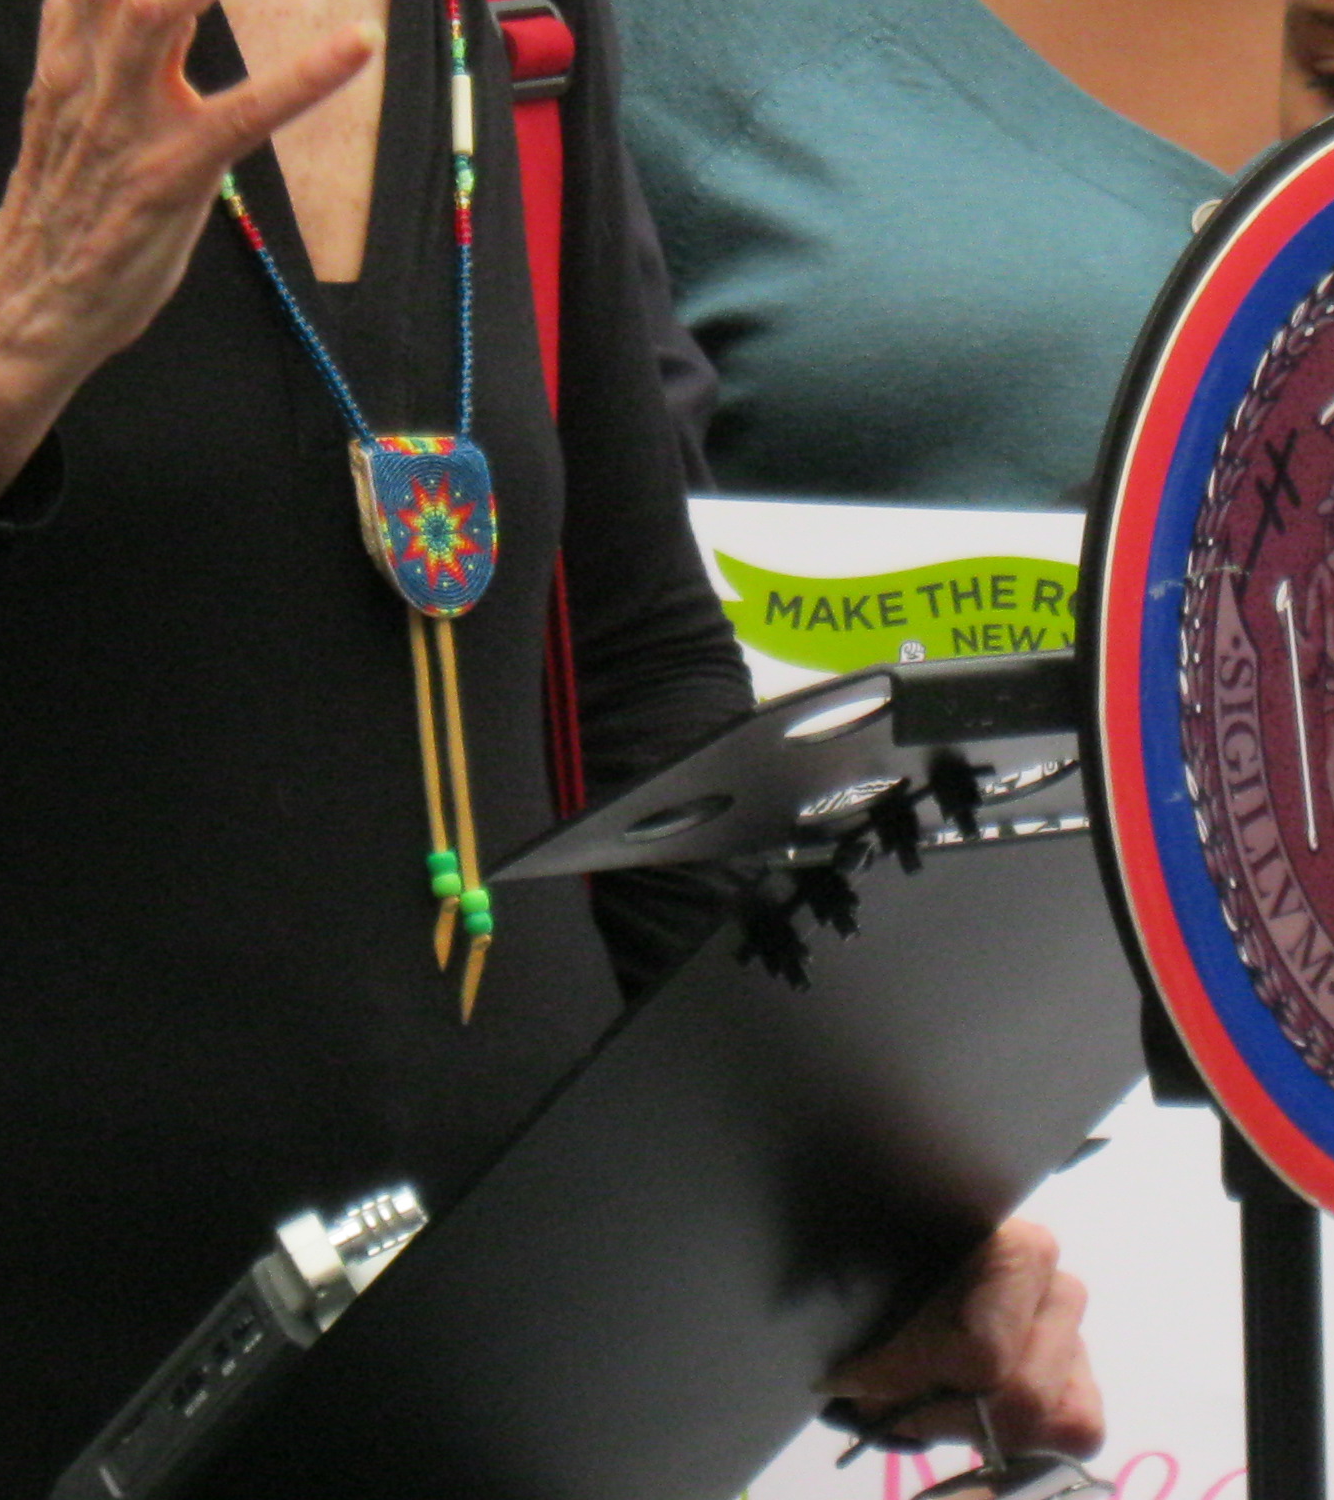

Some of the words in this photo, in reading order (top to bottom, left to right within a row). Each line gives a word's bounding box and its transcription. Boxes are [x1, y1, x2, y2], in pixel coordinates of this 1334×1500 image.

[764, 590, 908, 633] MAKE
[916, 574, 1018, 620] THE
[951, 624, 1049, 656] NEW
